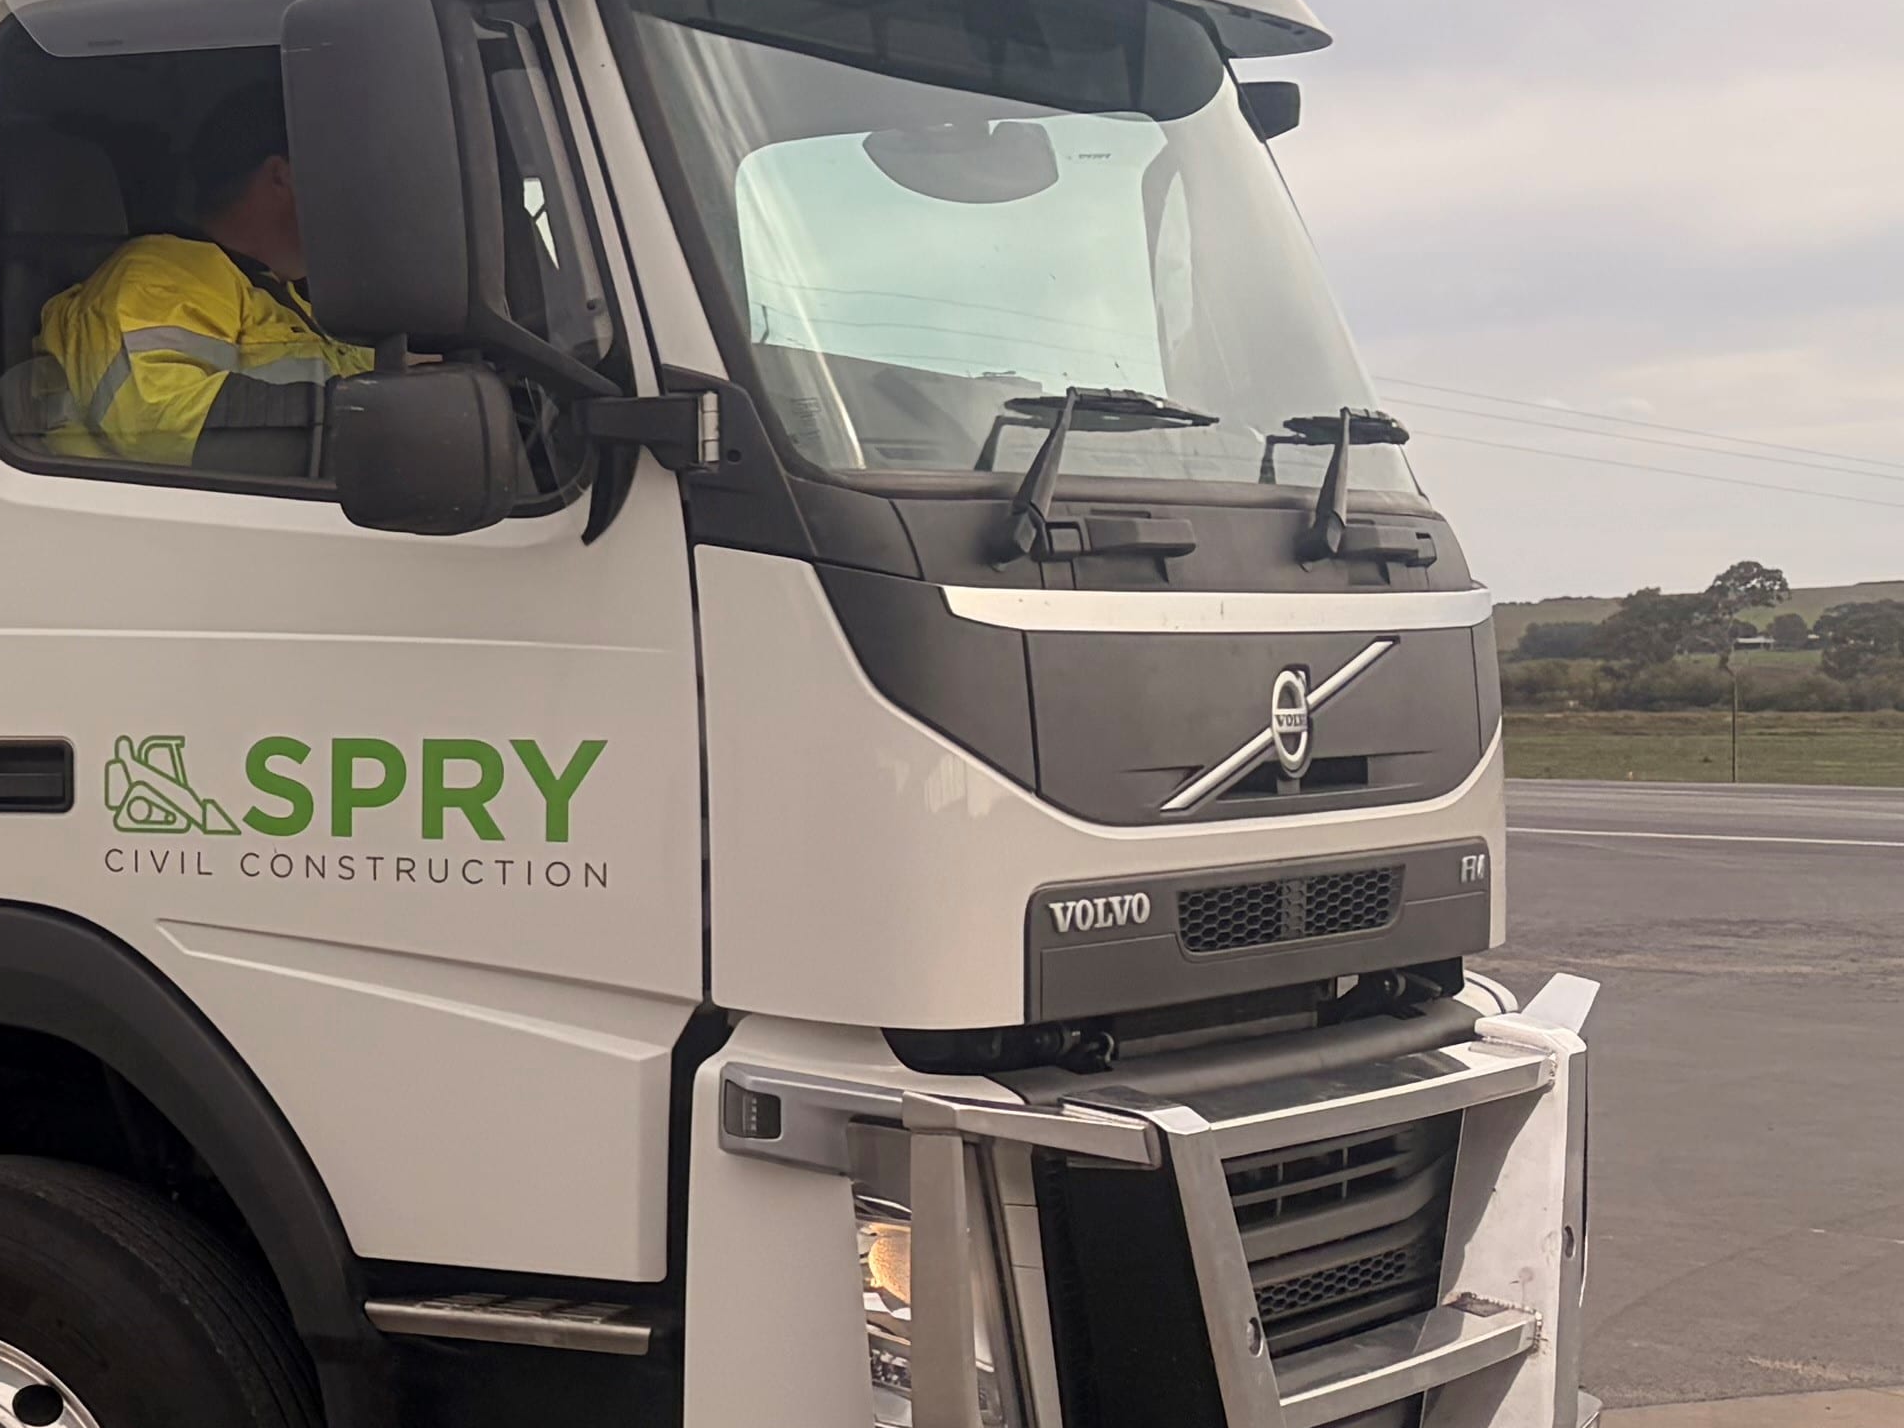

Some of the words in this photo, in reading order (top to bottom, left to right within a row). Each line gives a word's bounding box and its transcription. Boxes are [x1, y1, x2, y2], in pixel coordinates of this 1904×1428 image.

[242, 736, 609, 842] SPRY
[104, 848, 213, 876] CIVIL
[240, 852, 608, 889] CONSTRUCTION
[1048, 892, 1151, 933] VOLVO
